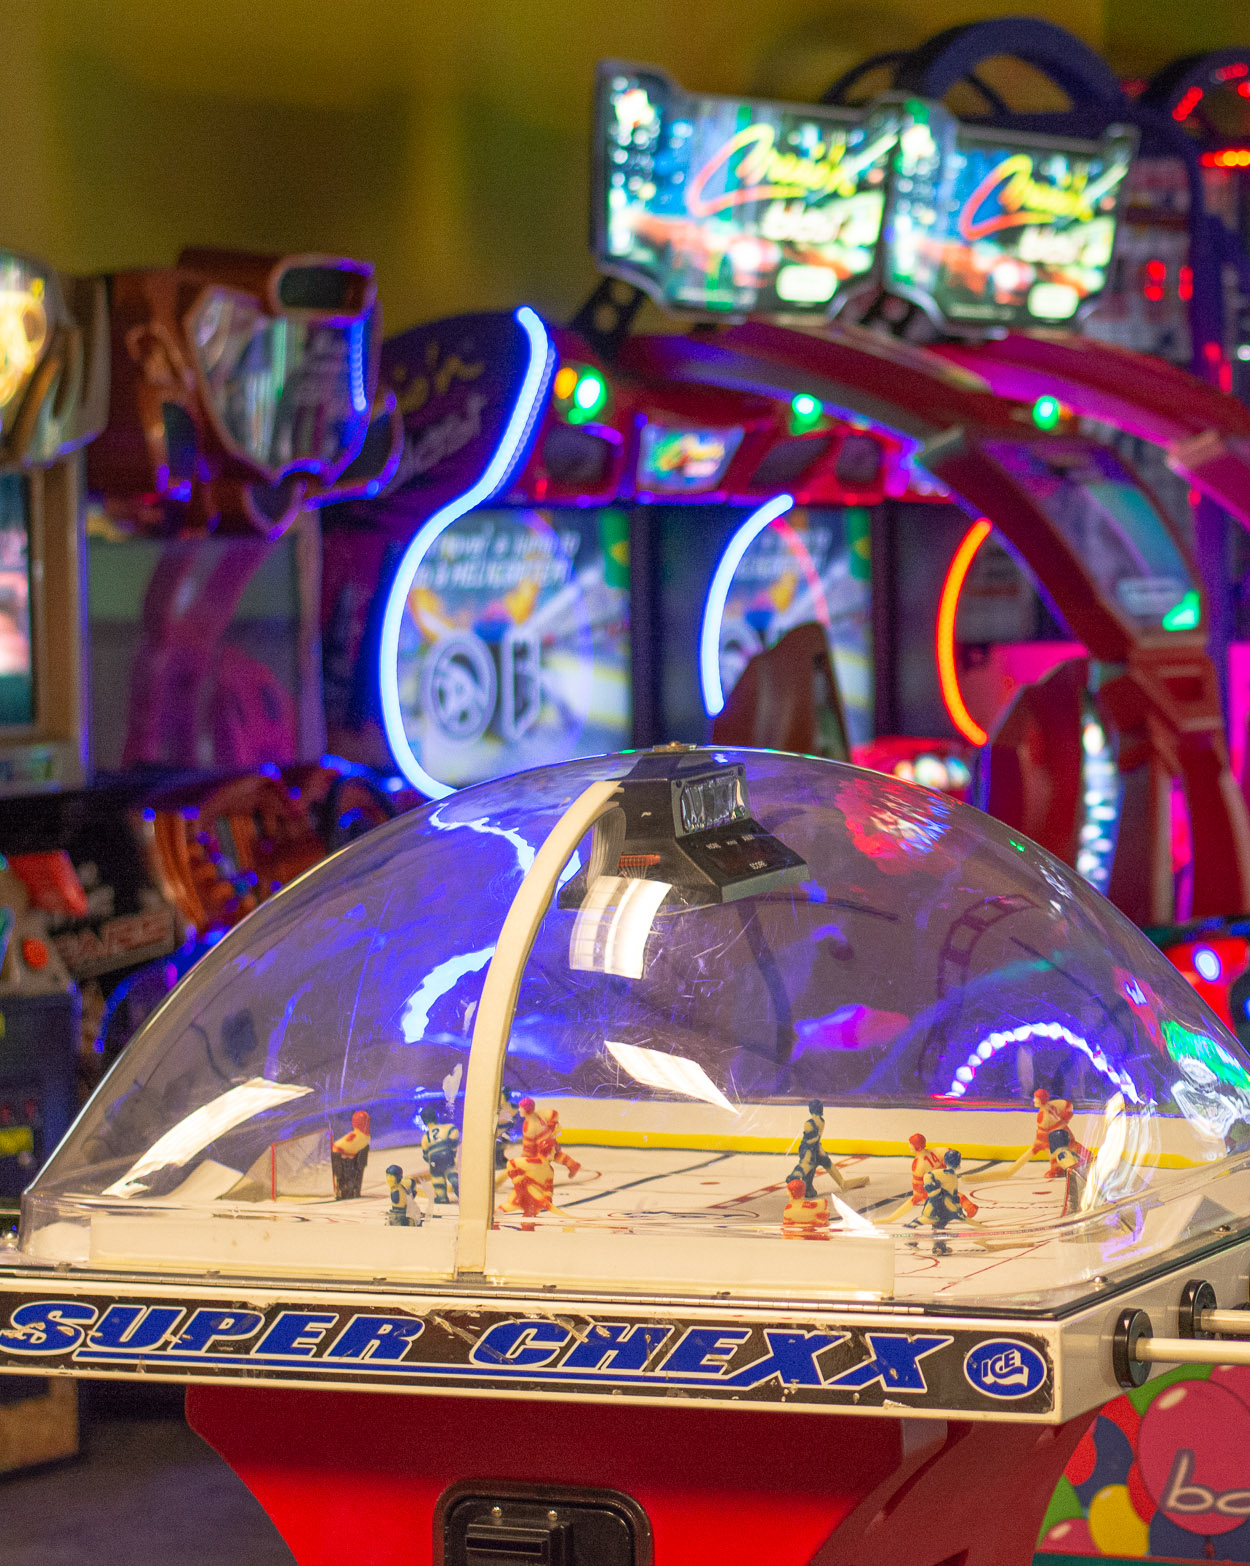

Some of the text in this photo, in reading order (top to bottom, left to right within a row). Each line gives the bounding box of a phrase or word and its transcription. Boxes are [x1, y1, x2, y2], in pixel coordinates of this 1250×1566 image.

[426, 1128, 440, 1143] 12
[0, 1301, 955, 1393] SUPER CHEXX
[981, 1348, 1030, 1387] ICE
